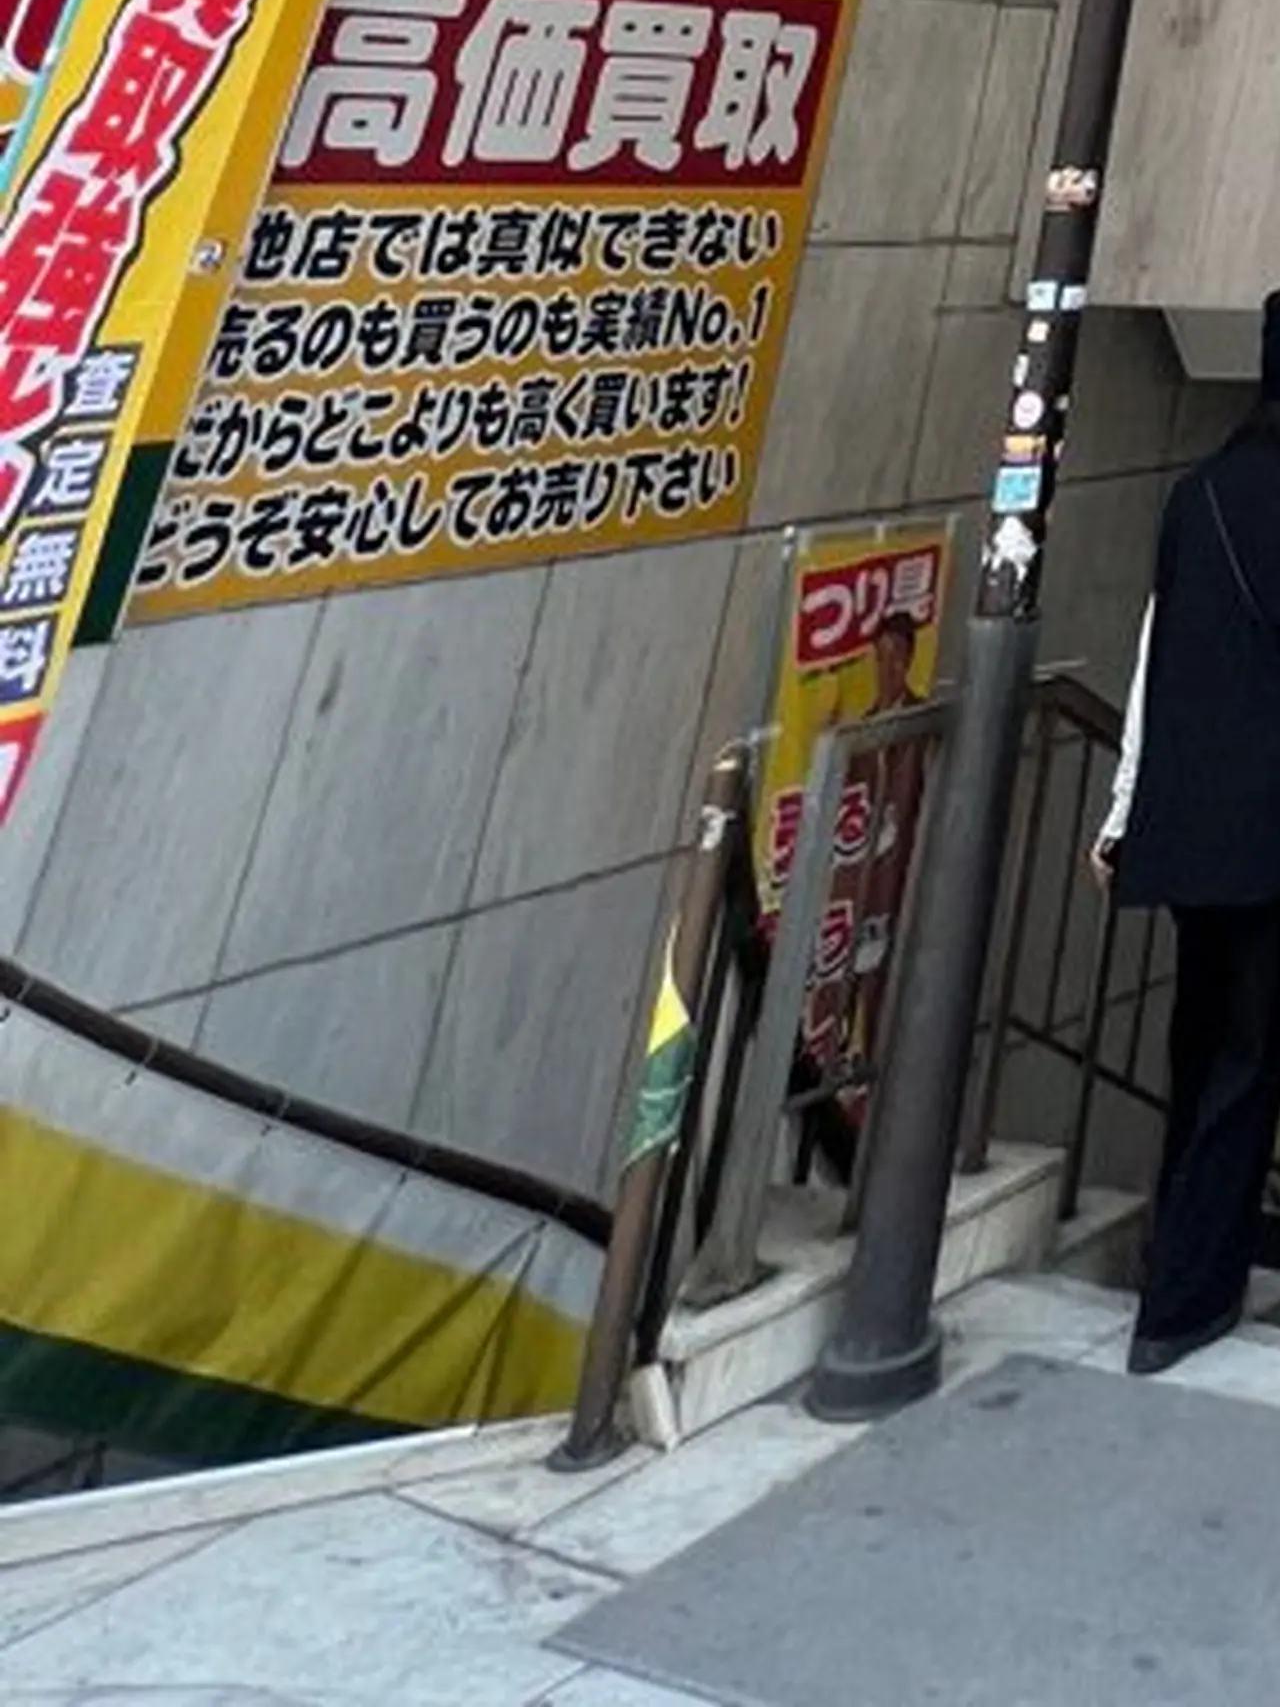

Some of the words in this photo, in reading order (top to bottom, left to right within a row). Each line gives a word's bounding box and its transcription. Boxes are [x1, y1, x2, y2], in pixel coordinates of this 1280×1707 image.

[243, 207, 778, 280] 他店では真似できない
[136, 448, 737, 583] どうぞ安心してお売り下さい
[803, 553, 934, 649] つり具
